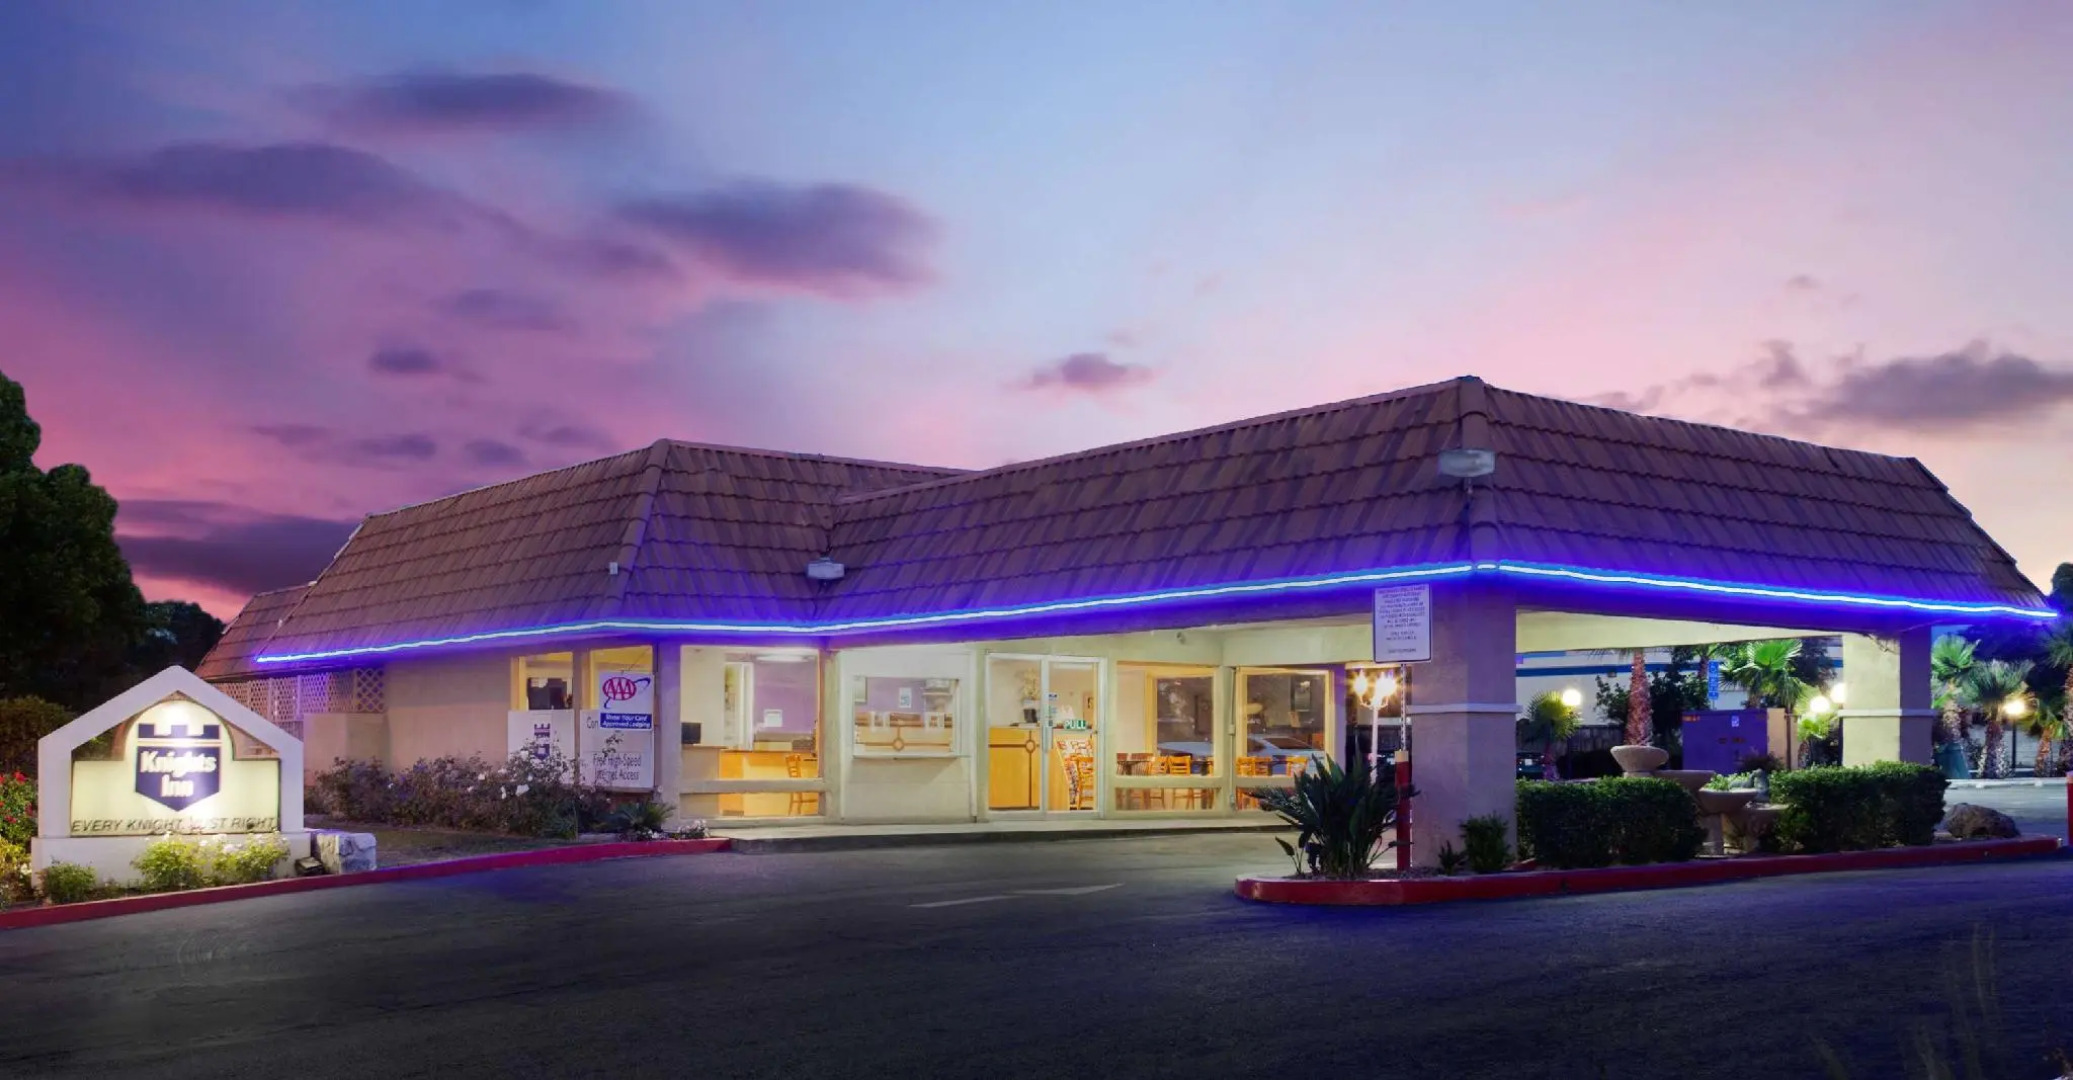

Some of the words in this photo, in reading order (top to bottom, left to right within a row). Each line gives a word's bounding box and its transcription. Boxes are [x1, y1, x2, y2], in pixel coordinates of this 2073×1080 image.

[1064, 719, 1086, 730] PULL
[140, 751, 217, 777] Knights
[161, 774, 194, 797] Inn
[72, 819, 122, 832] EVERY
[126, 817, 184, 832] KNIGHT
[231, 817, 276, 831] RIGHT
